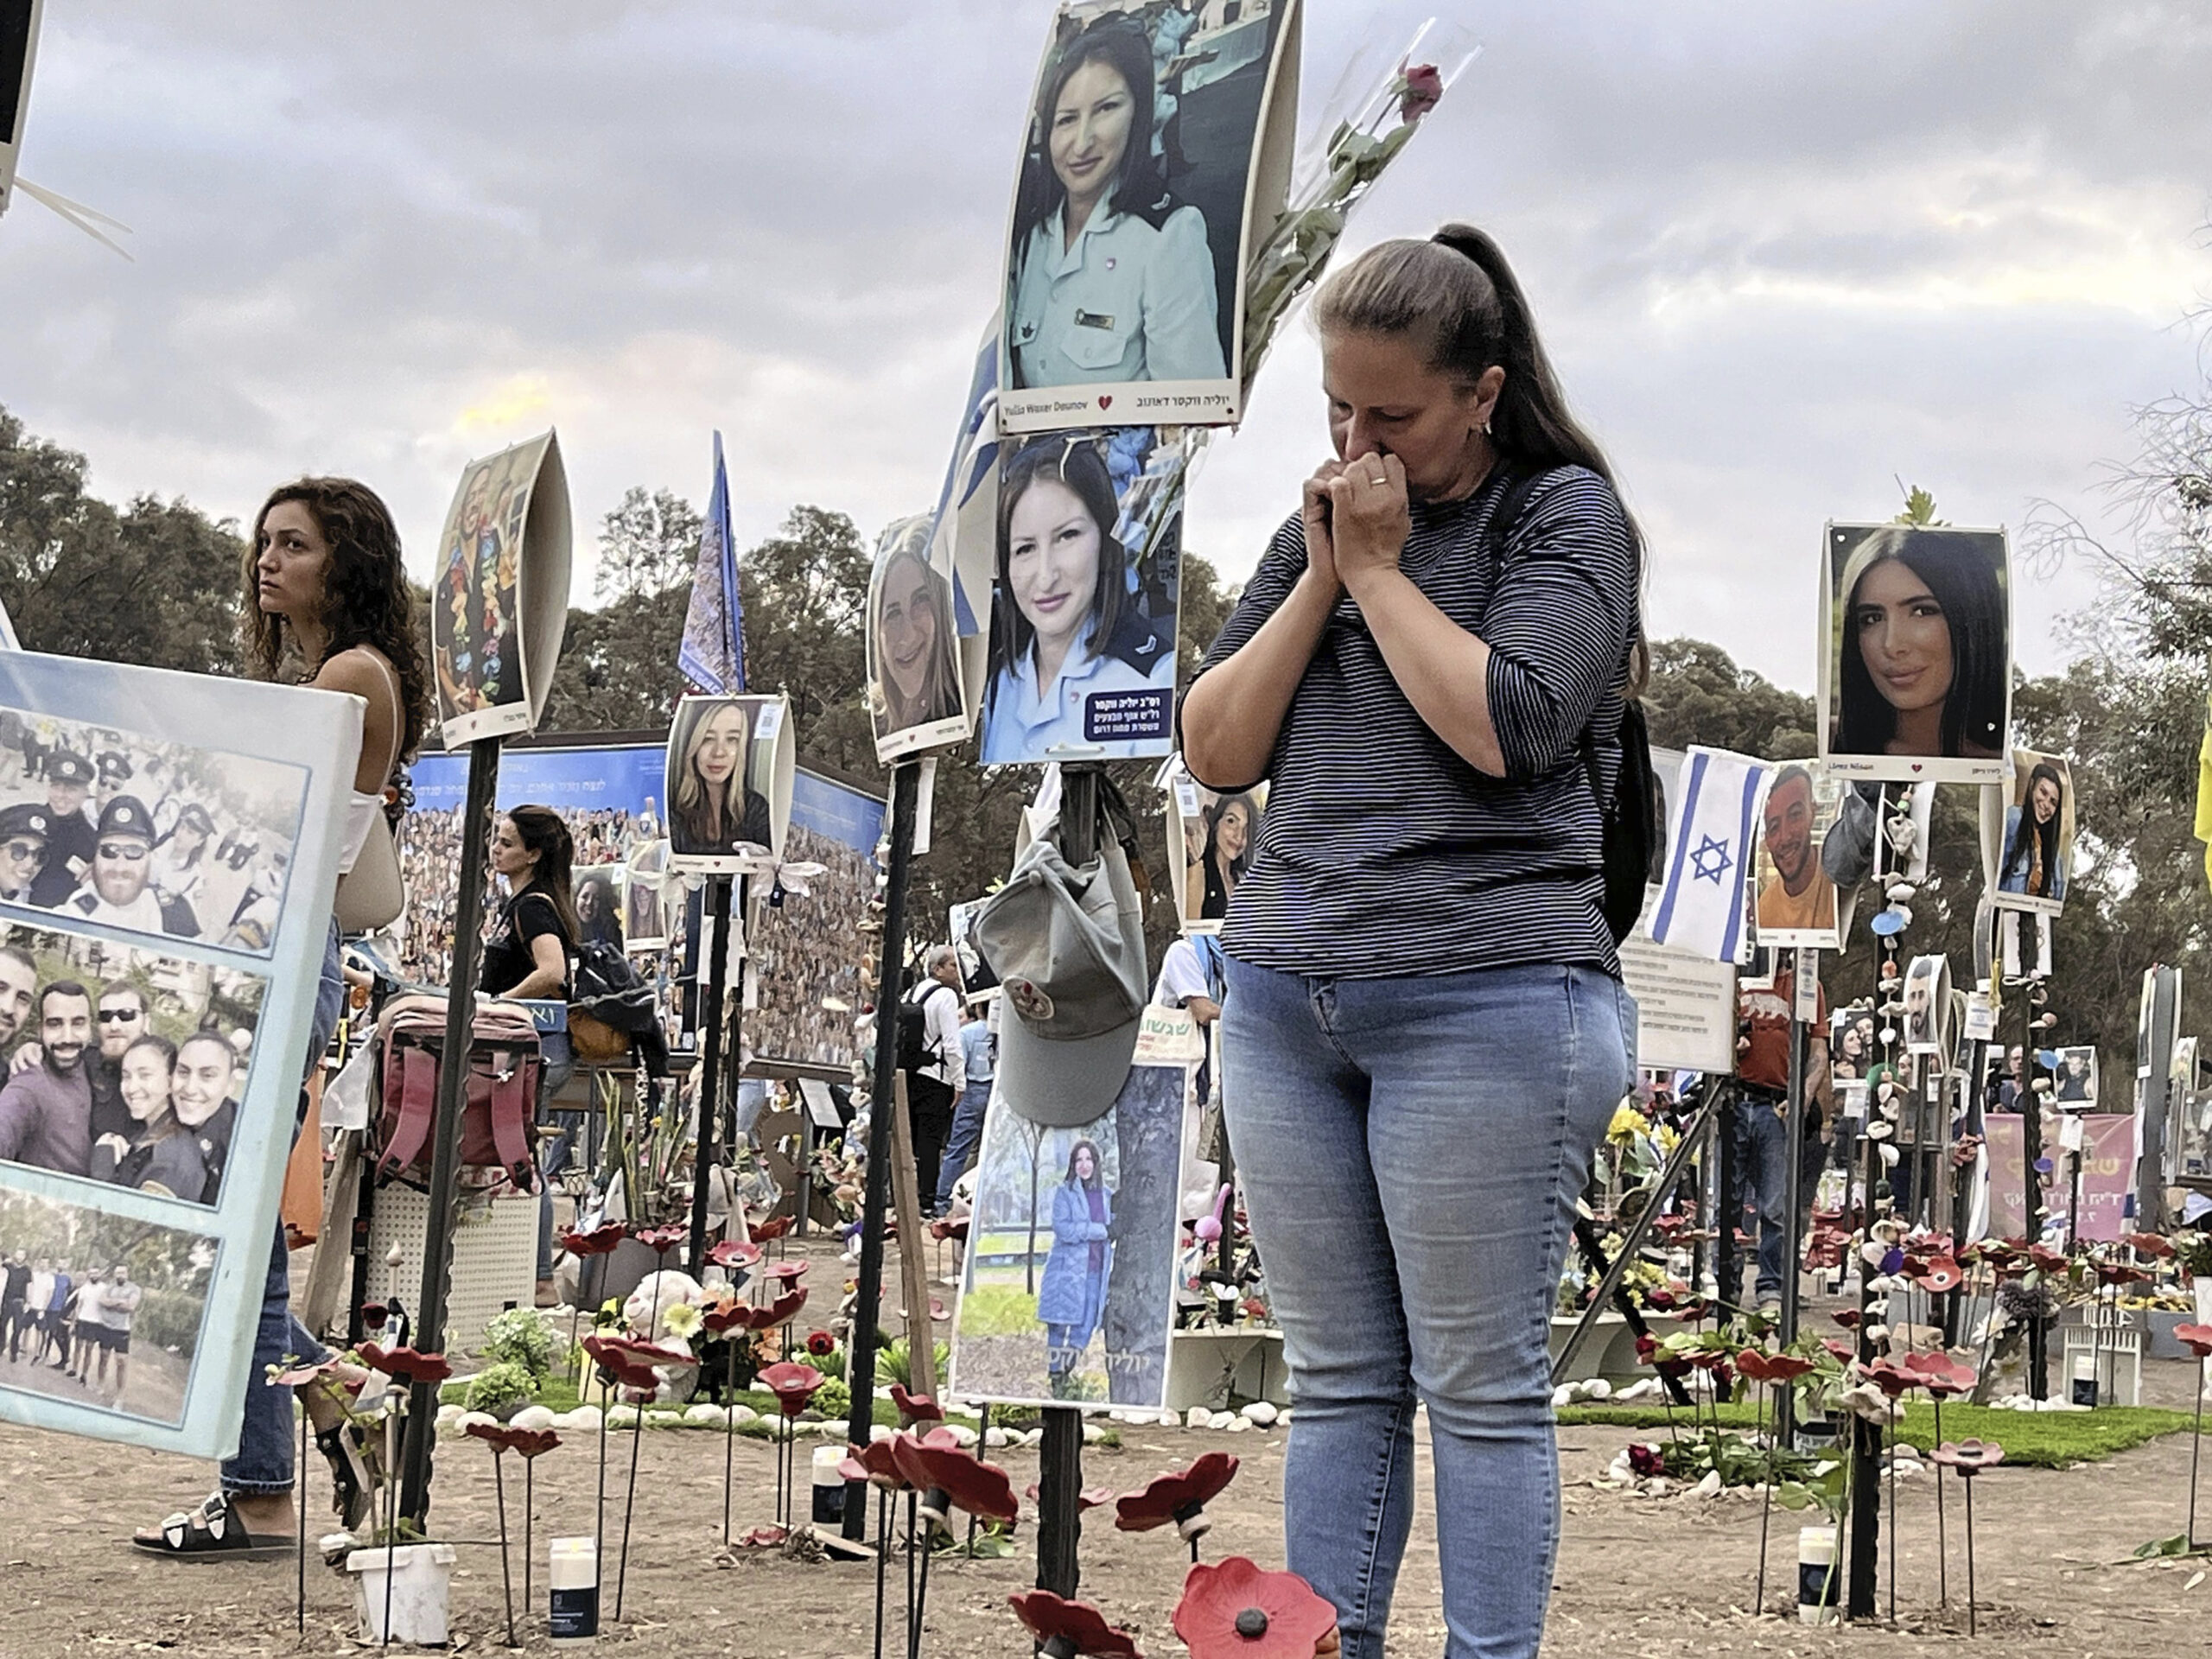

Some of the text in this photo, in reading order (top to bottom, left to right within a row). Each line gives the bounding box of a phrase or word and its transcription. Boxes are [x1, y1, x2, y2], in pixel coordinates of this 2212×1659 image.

[1203, 394, 1230, 405] יוליה
[1118, 696, 1139, 709] יוליה
[1140, 1019, 1191, 1036] שגשו
